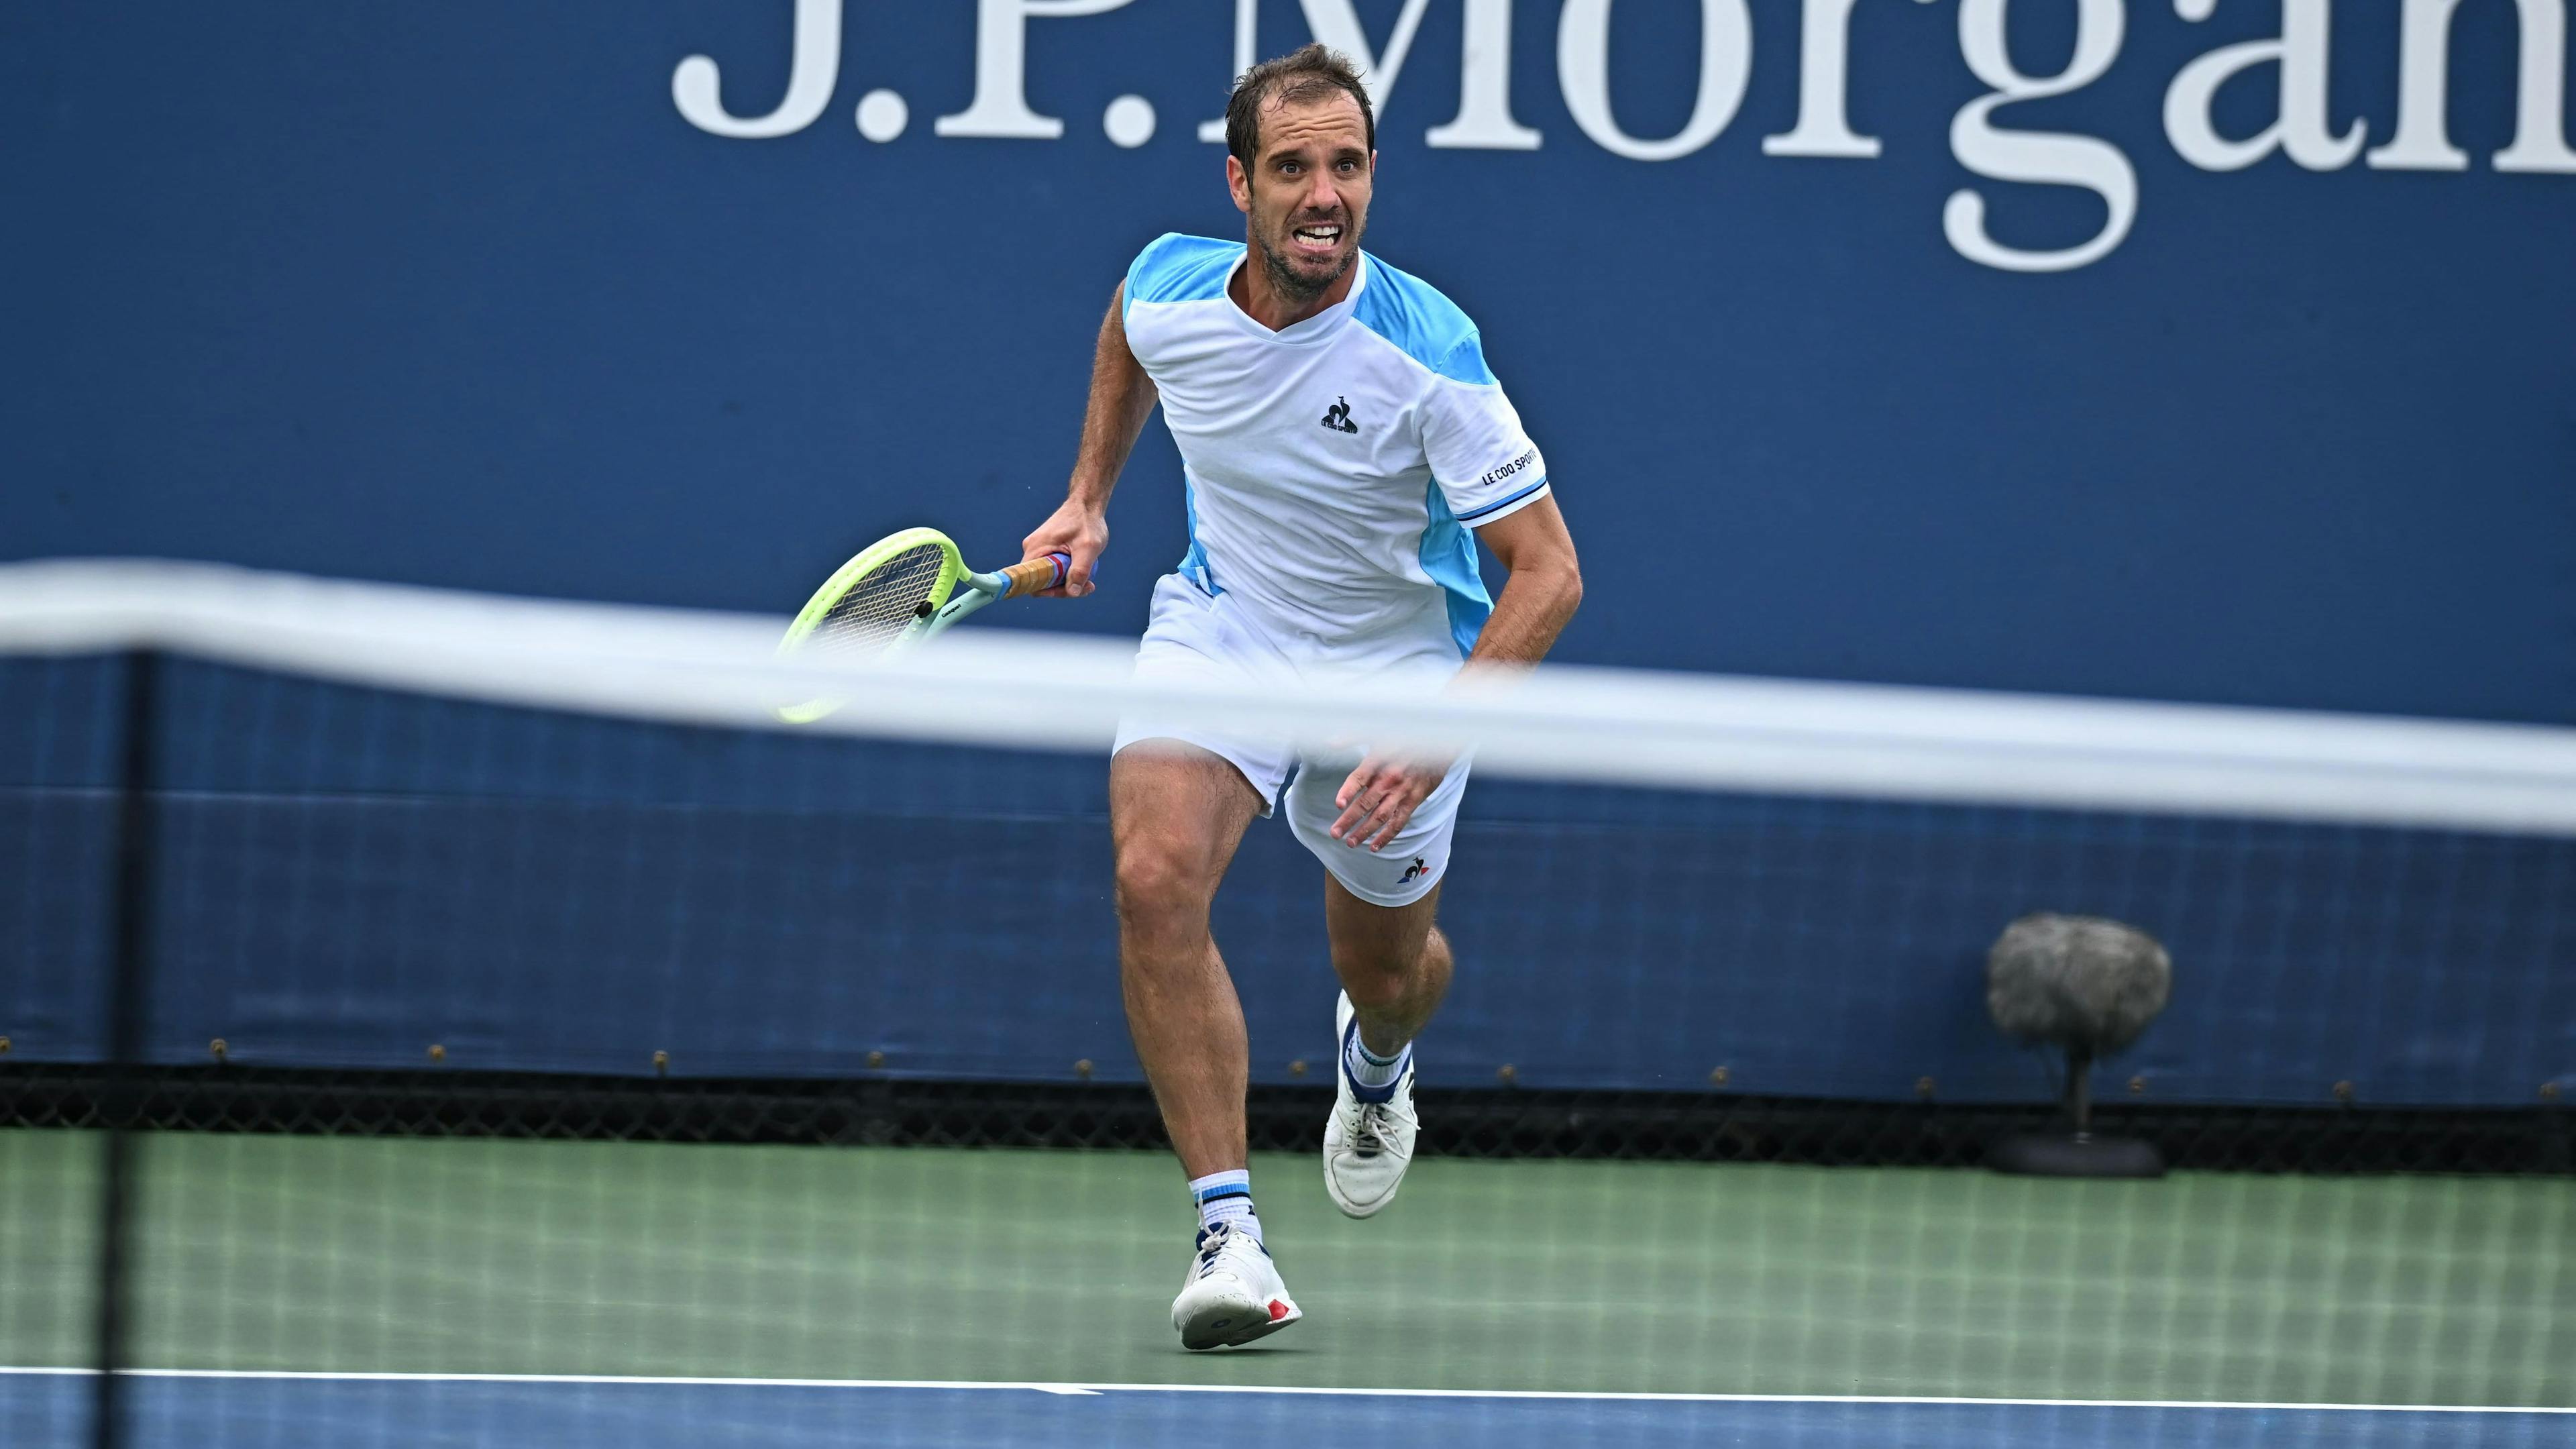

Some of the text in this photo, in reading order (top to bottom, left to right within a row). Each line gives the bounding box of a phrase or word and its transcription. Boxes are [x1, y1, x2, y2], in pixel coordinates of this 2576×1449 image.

[1482, 447, 1537, 486] LE COQ SPORTI
